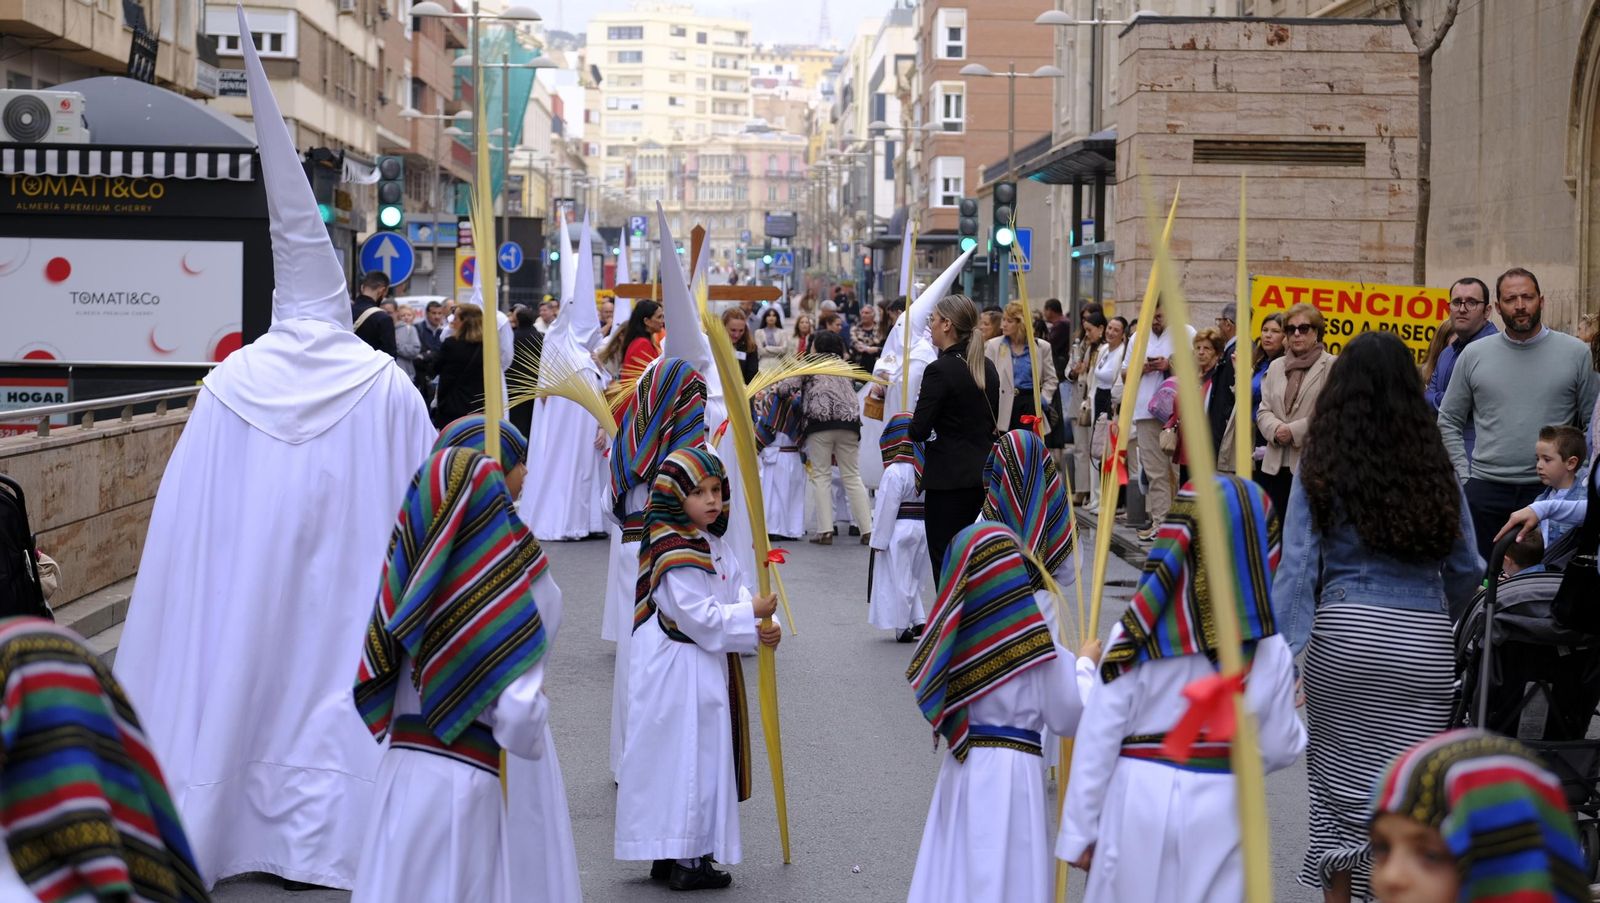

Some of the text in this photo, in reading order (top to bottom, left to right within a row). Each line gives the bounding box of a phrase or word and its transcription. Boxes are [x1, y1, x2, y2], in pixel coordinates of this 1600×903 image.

[64, 203, 110, 212] PREMIUM
[114, 204, 153, 213] CHERRY
[69, 291, 160, 305] TOMATI&Co
[1259, 285, 1450, 321] ATENCIÓN
[7, 392, 64, 404] HOGAR
